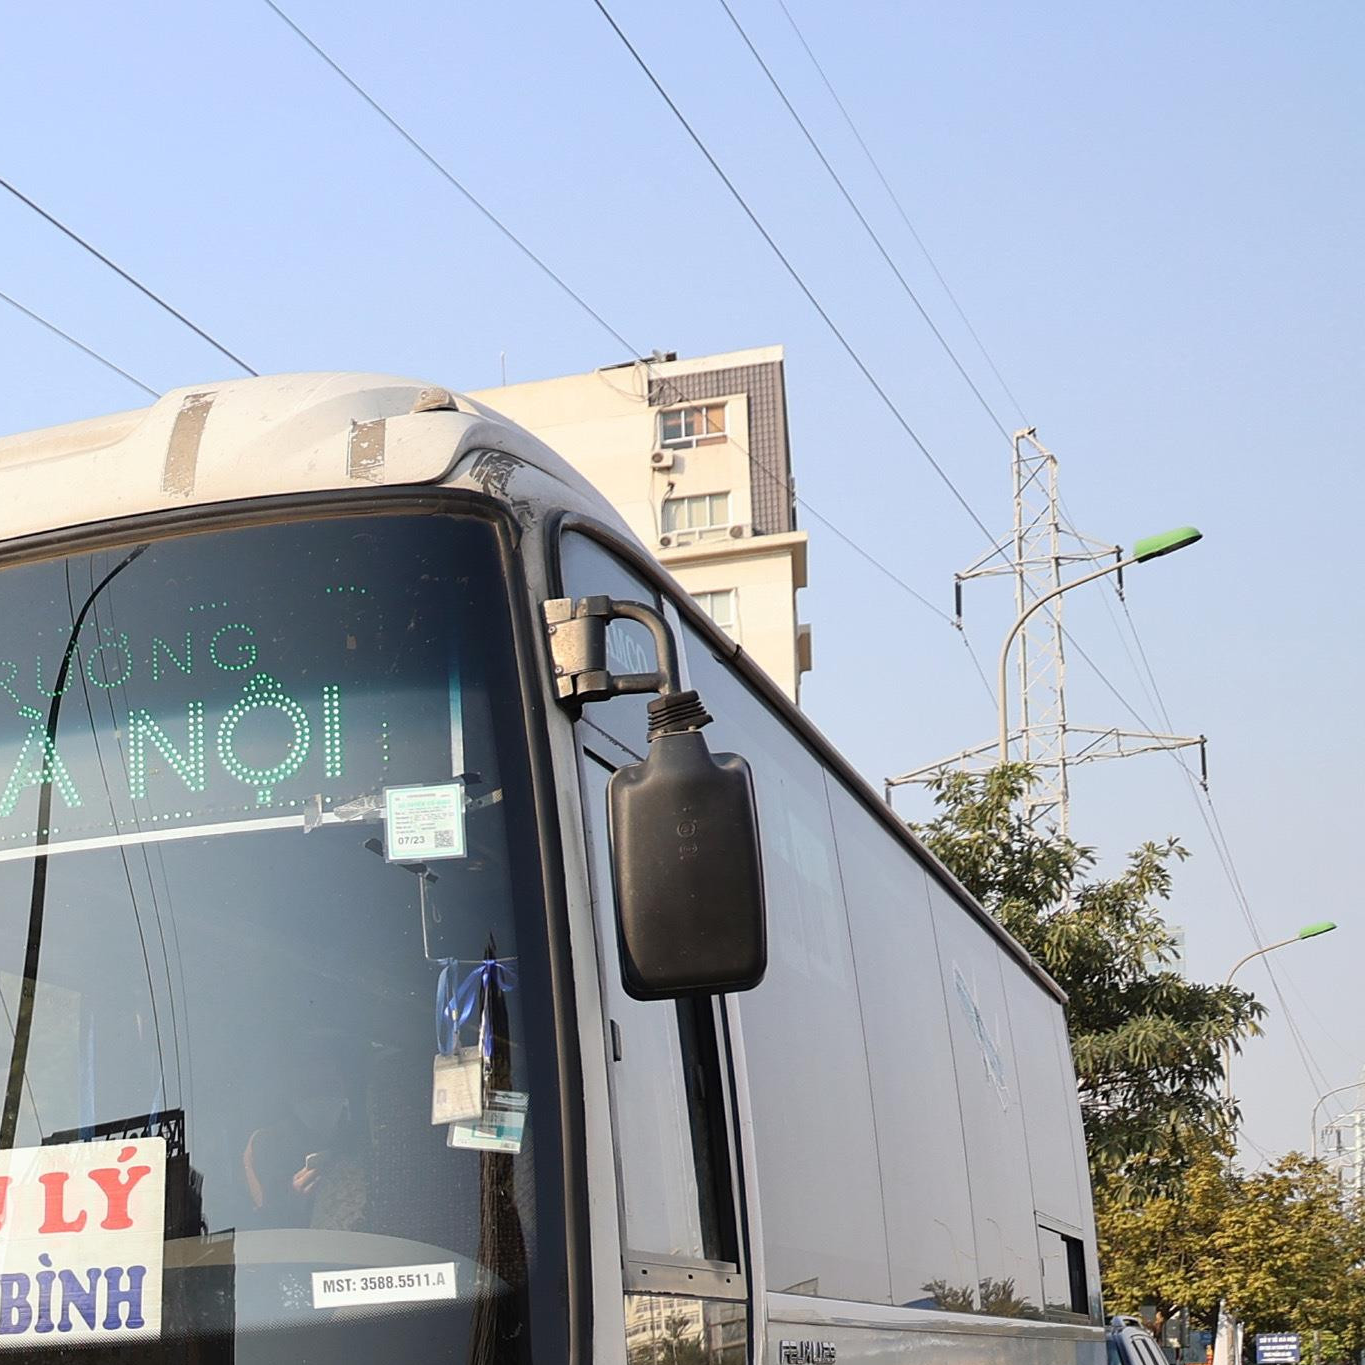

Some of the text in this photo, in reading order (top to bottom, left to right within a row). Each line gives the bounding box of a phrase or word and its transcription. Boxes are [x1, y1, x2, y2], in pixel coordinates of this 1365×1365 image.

[128, 671, 345, 805] NỘI
[397, 835, 425, 845] 07/23
[38, 1145, 152, 1235] LÝ
[323, 1278, 358, 1293] MST:
